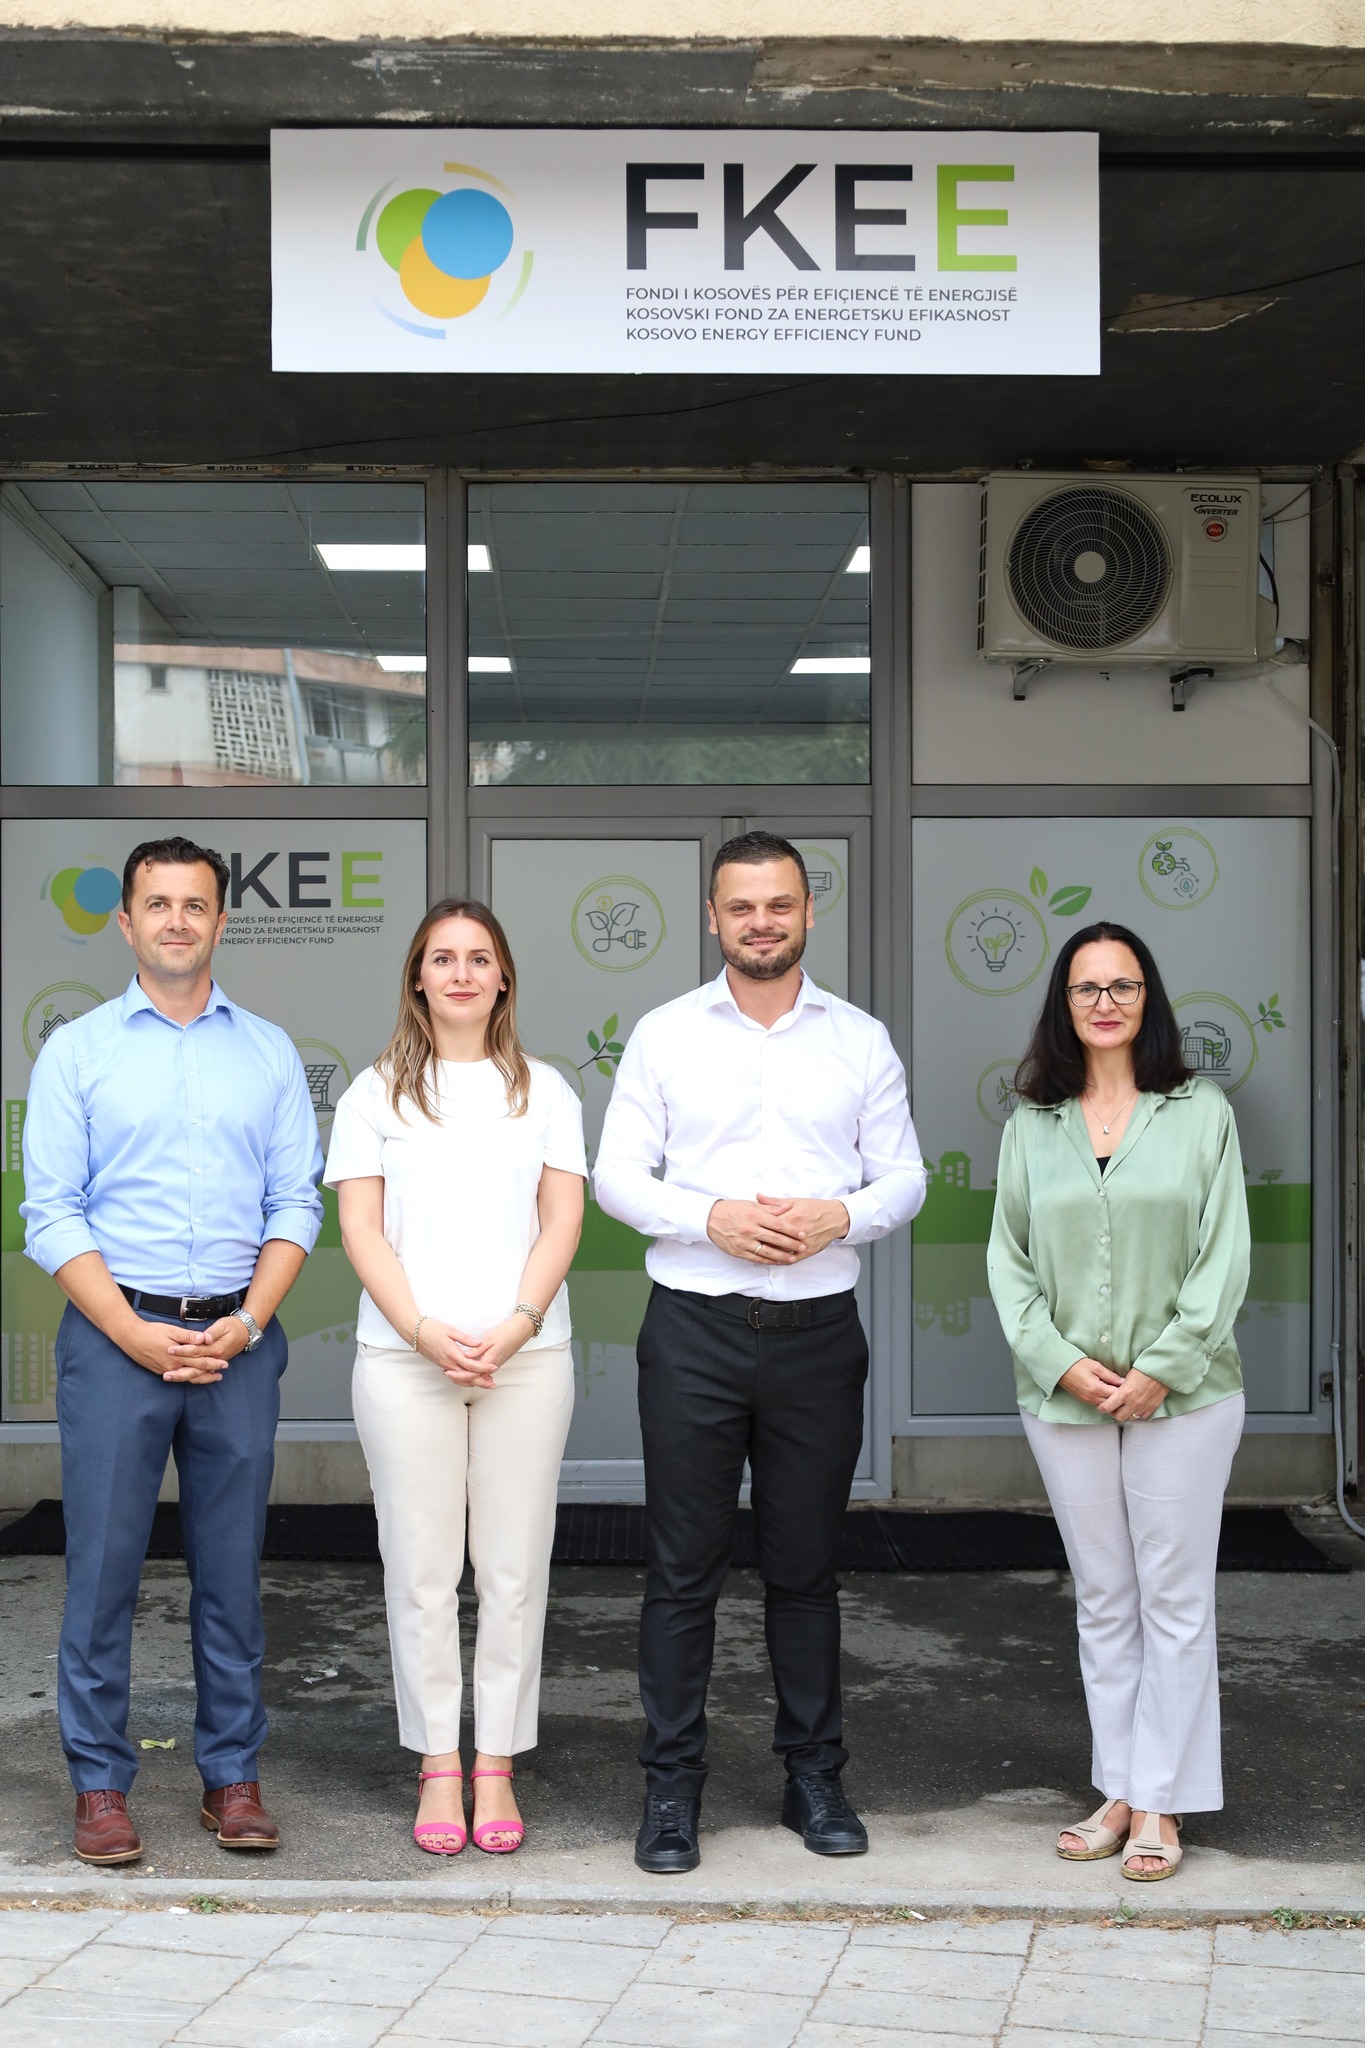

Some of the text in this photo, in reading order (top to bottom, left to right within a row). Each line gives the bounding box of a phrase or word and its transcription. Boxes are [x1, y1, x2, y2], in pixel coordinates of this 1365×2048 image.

[626, 162, 1018, 272] FKEE
[626, 285, 1018, 303] FONDI I KOSOVËS PËR EFIÇIENCË TË ENERGJISË
[626, 307, 1011, 322] KOSOVSKI FOND ZA ENERGETSKU EFIKASNOST
[626, 327, 922, 342] KOSOVO ENERGY EFFICIENCY FUND
[1190, 494, 1242, 503] ECOLUX
[1196, 507, 1239, 516] INVERTER
[230, 851, 385, 909] KEE
[227, 915, 385, 925] SOVËS PËR EFIÇIENCË TË ENERGJISË
[226, 926, 381, 935] FOND ZA ENERGETSKU EFIKASNOST
[219, 936, 335, 945] ENERGY EFFICIENCY FUND
